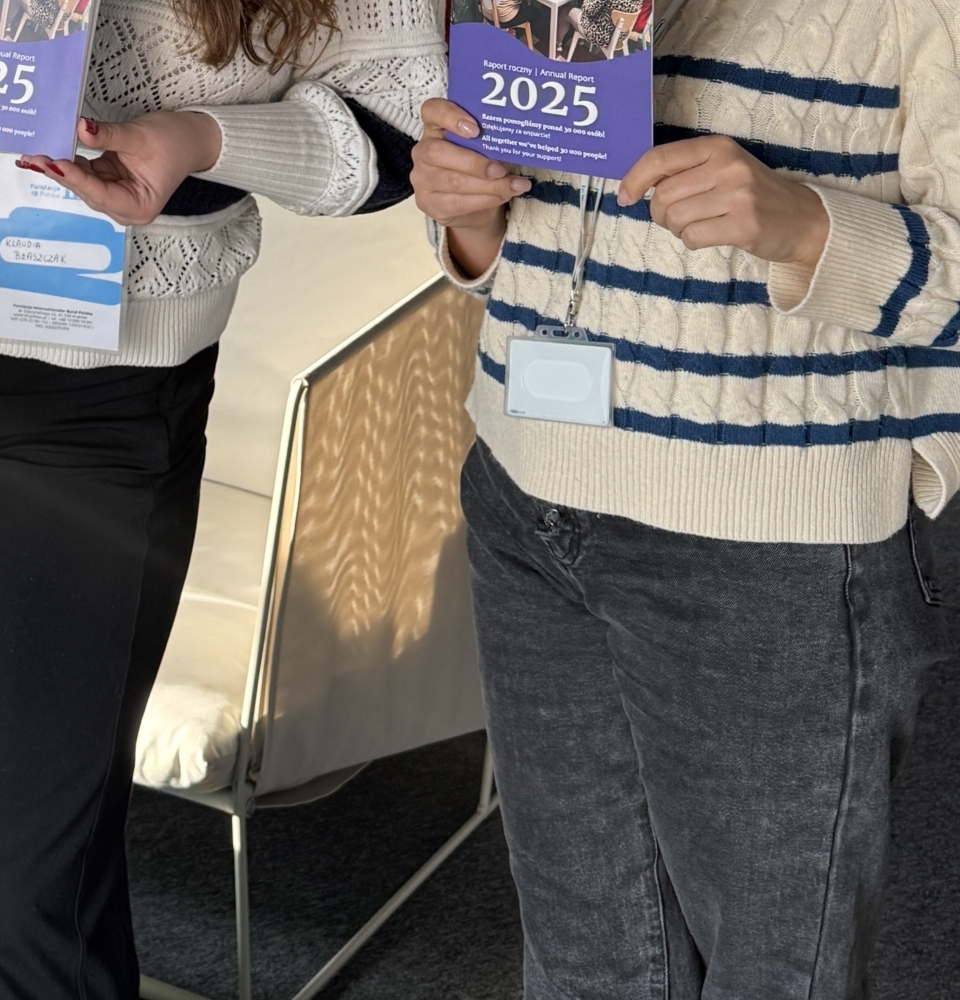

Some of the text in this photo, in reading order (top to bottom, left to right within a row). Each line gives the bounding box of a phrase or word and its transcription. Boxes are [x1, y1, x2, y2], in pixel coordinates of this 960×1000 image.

[13, 52, 36, 63] Report
[483, 60, 507, 70] Raport
[508, 65, 533, 75] roczny
[540, 69, 566, 79] Annual
[568, 72, 595, 84] Report
[481, 72, 599, 127] 2025
[30, 183, 60, 192] Fundacja
[13, 250, 67, 264] BŁASZCZAK
